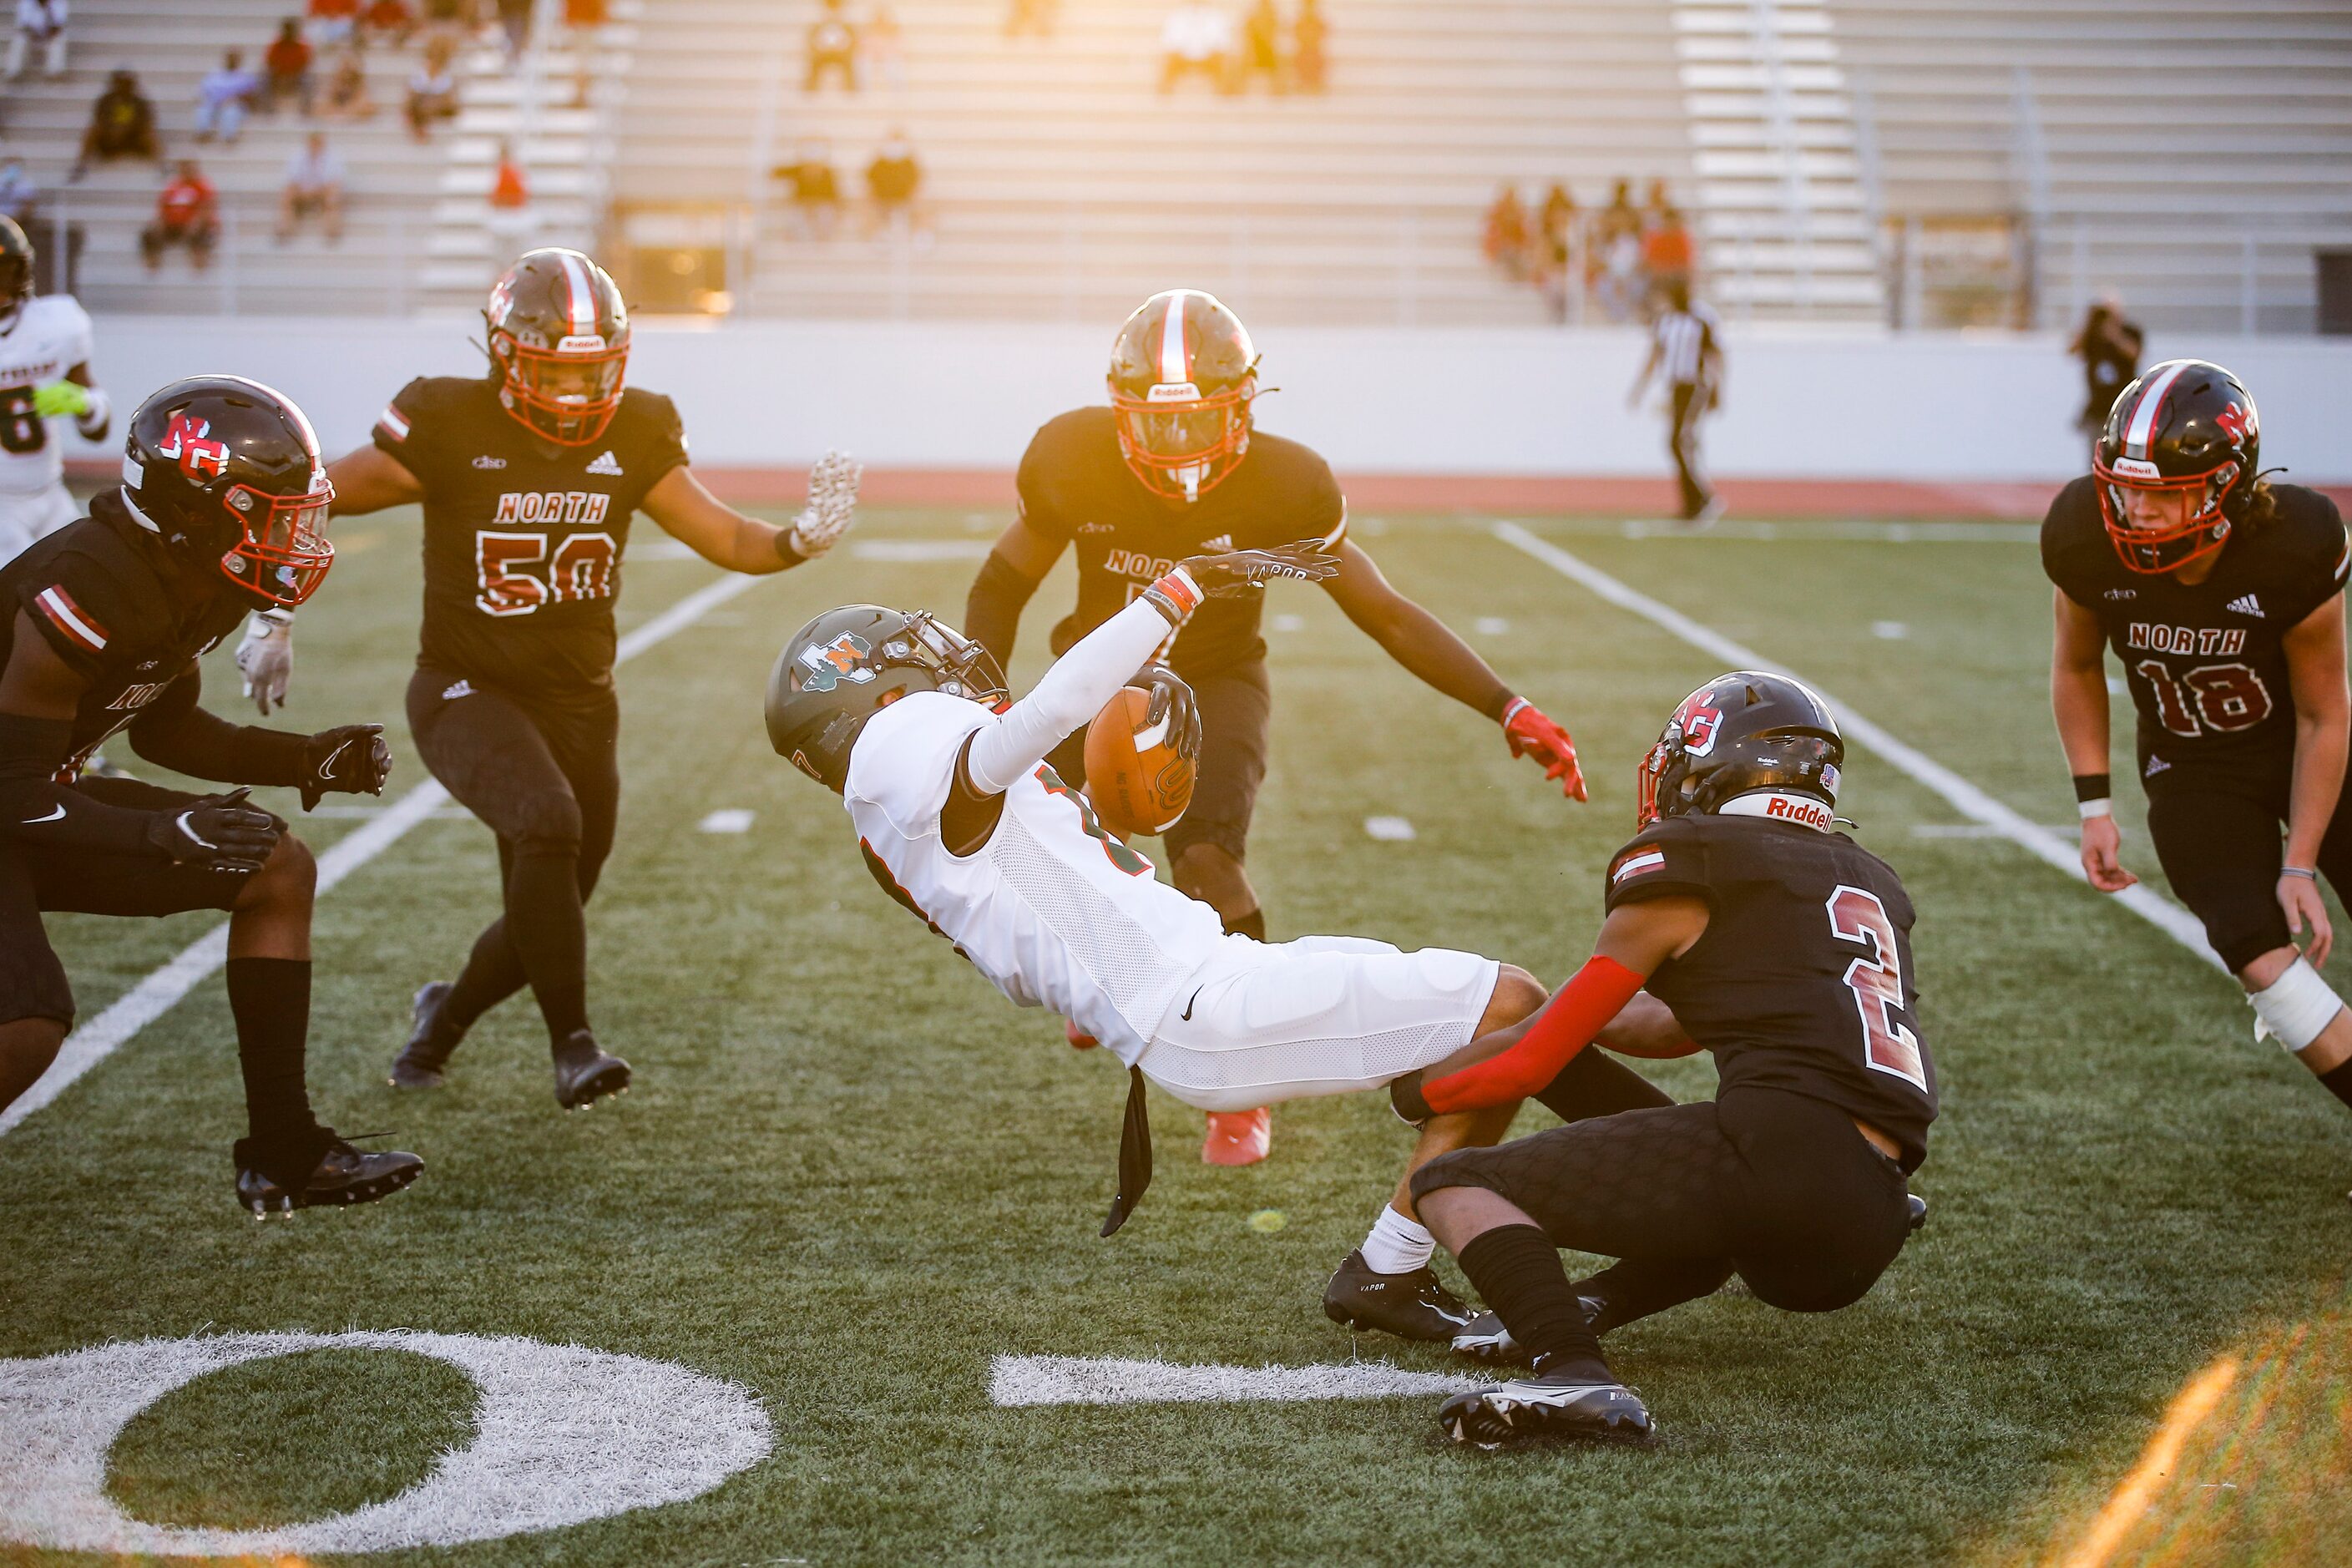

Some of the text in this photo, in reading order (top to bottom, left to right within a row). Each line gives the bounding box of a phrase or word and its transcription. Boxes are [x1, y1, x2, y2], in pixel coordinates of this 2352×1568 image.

[492, 491, 610, 524] NORTH
[475, 529, 617, 625] 50
[2127, 622, 2247, 656] NORTH
[2136, 659, 2274, 737] 18
[1767, 797, 1833, 832] Riddell
[1825, 884, 1929, 1095] 2
[1360, 1282, 1386, 1292] VAPOR
